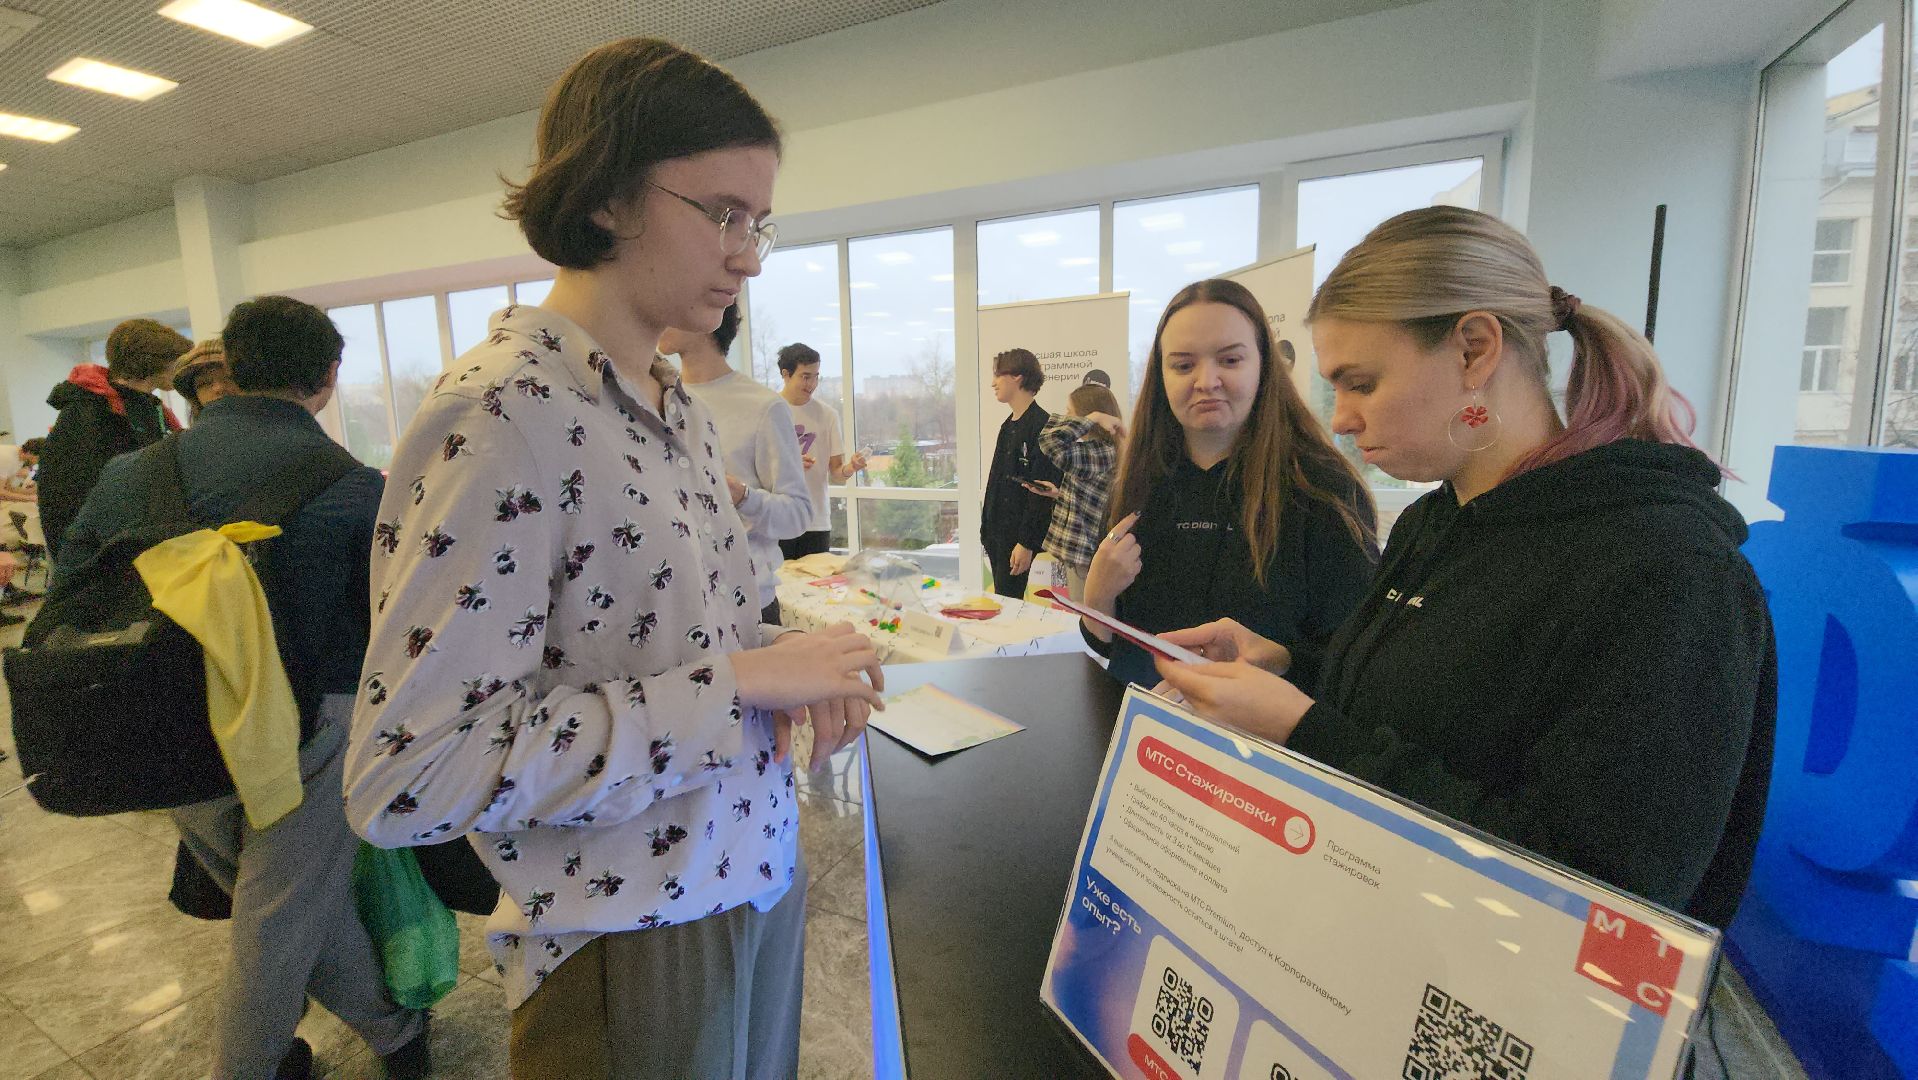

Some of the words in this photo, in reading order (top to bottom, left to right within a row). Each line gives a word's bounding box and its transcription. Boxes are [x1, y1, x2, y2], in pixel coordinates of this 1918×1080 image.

[1035, 351, 1061, 360] сшая
[1063, 349, 1098, 358] школа
[1042, 373, 1080, 382] енерии
[1145, 746, 1175, 771] МТС
[1175, 763, 1277, 826] Стажировки
[1195, 823, 1240, 854] направлений
[1193, 851, 1221, 874] месяцев
[1323, 854, 1381, 889] стажировок
[1327, 839, 1381, 875] Программа
[1203, 874, 1228, 894] оплата
[1082, 896, 1121, 935] опыт?
[1086, 875, 1110, 906] Уже
[1111, 902, 1142, 935] есть
[1184, 906, 1213, 931] остаться
[1191, 893, 1206, 909] МТС
[1205, 905, 1237, 935] Premium,
[1239, 931, 1267, 955] доступ
[1274, 954, 1352, 1016] Корпоративному
